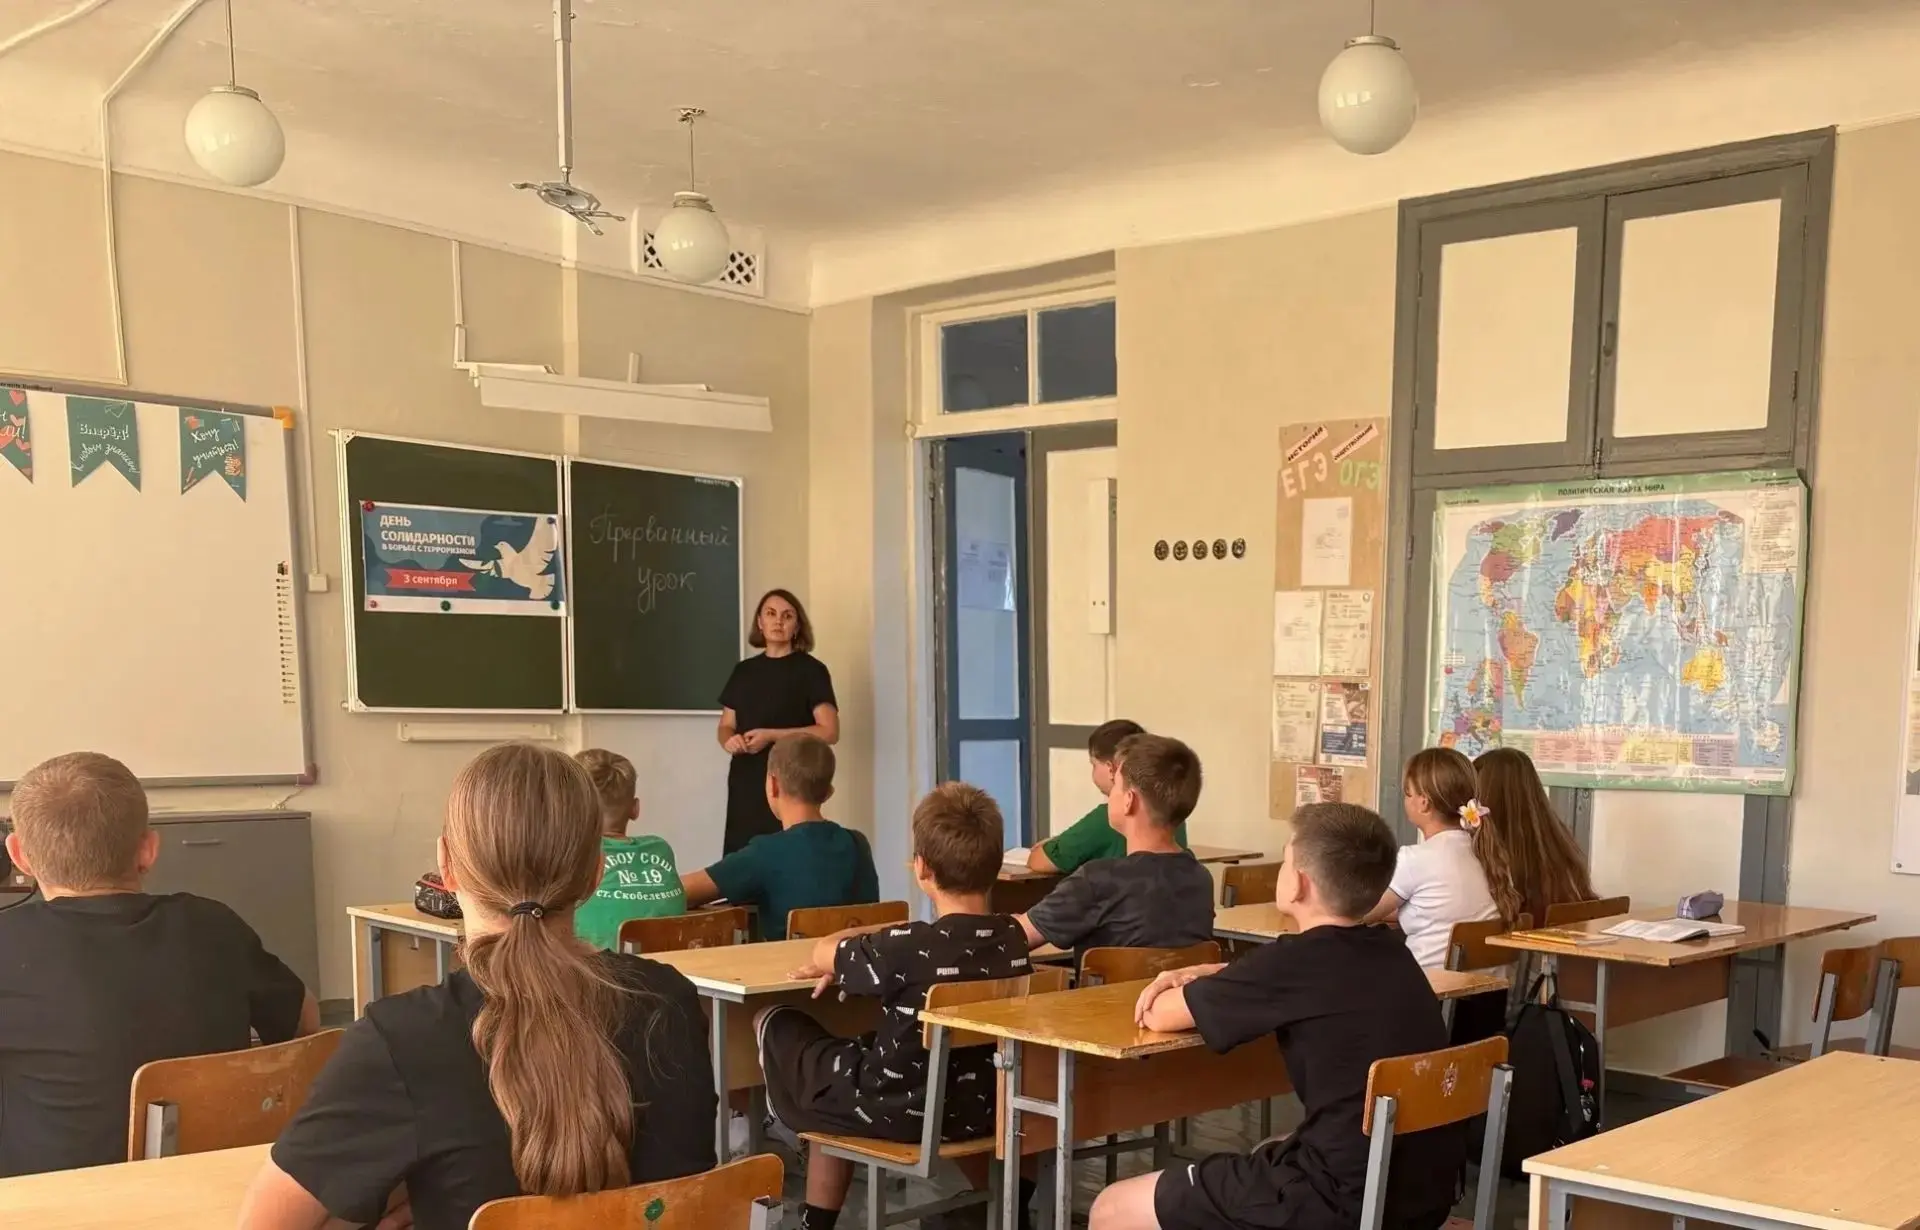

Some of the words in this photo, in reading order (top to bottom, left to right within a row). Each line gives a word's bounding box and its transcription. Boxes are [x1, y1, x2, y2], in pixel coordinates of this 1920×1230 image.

[191, 428, 220, 444] Хочу
[192, 438, 239, 469] учиться!
[1281, 452, 1328, 499] ЕГЭ
[1340, 459, 1380, 490] ОГЭ
[1557, 486, 1615, 496] ПОЛИТИЧЕСКАЯ
[1617, 485, 1642, 493] КАРТА
[1644, 483, 1665, 491] МИРА
[380, 515, 412, 528] ДЕНЬ
[381, 530, 475, 546] СОЛИДАРНОСТИ
[388, 544, 416, 552] БОРЬБЕ
[424, 546, 476, 555] ТЕРРОРИЗМОМ
[403, 574, 410, 584] 3
[412, 575, 458, 587] сентября
[637, 566, 696, 614] урок
[640, 852, 672, 872] СОШ
[618, 869, 639, 884] №
[641, 869, 662, 884] 19
[596, 889, 612, 898] ст.
[1011, 958, 1027, 968] PUMA
[936, 967, 959, 976] PUMA
